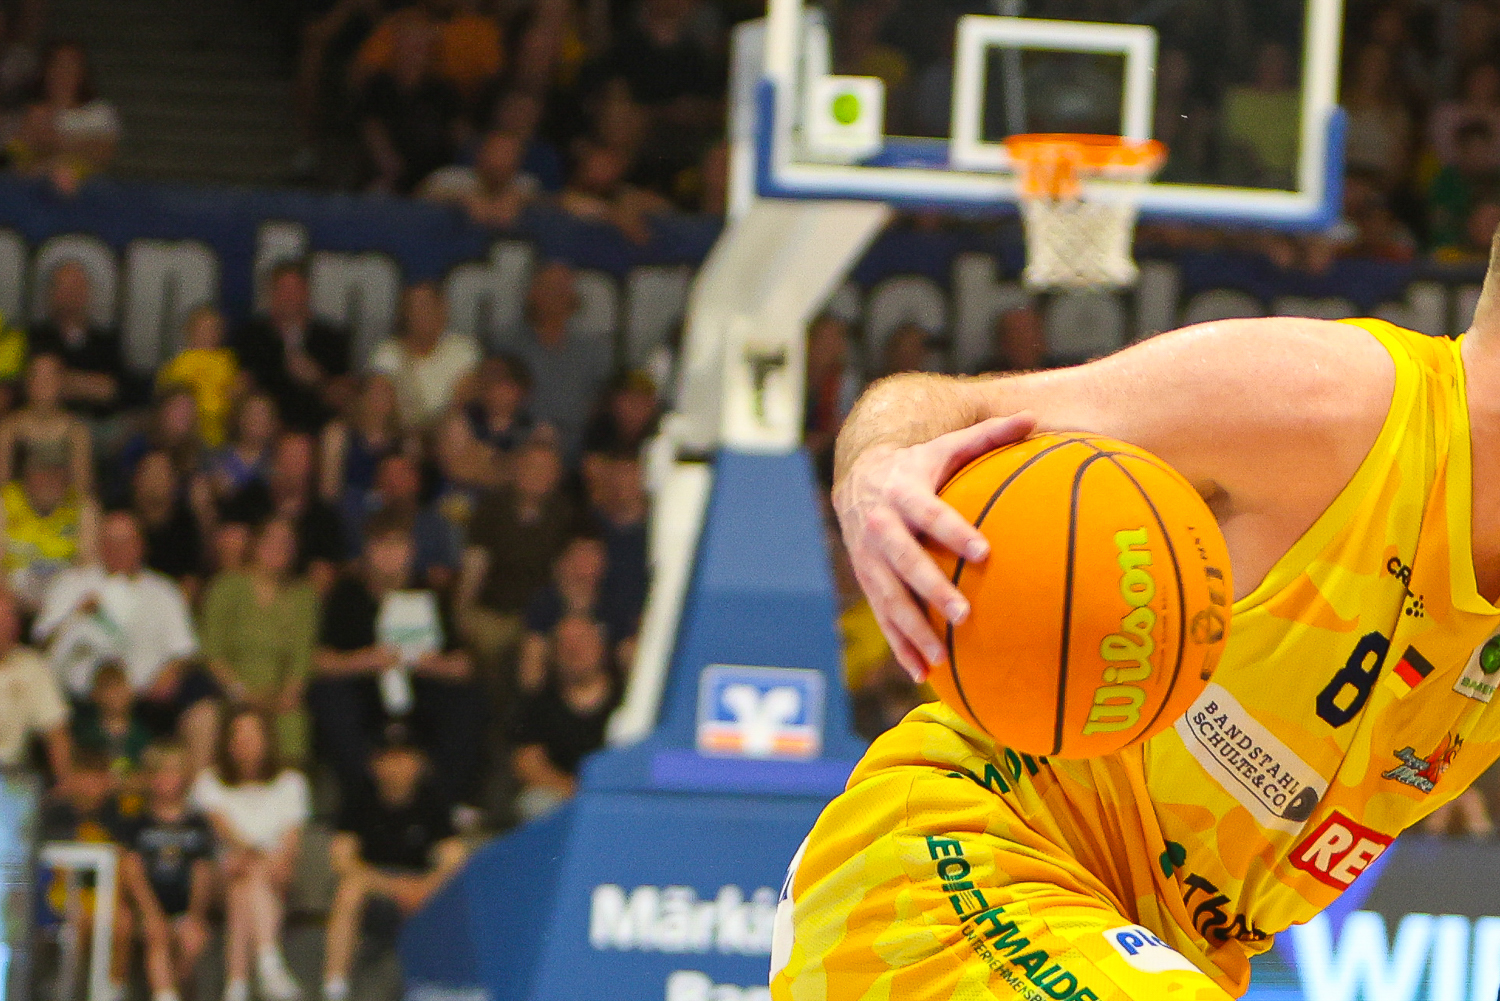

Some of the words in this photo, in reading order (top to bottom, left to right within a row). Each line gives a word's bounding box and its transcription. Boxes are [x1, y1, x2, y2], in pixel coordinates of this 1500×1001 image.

[1081, 525, 1157, 736] Wilson
[1316, 630, 1390, 728] 8
[1204, 700, 1300, 796] BANDSTAHL
[1300, 822, 1387, 885] RE
